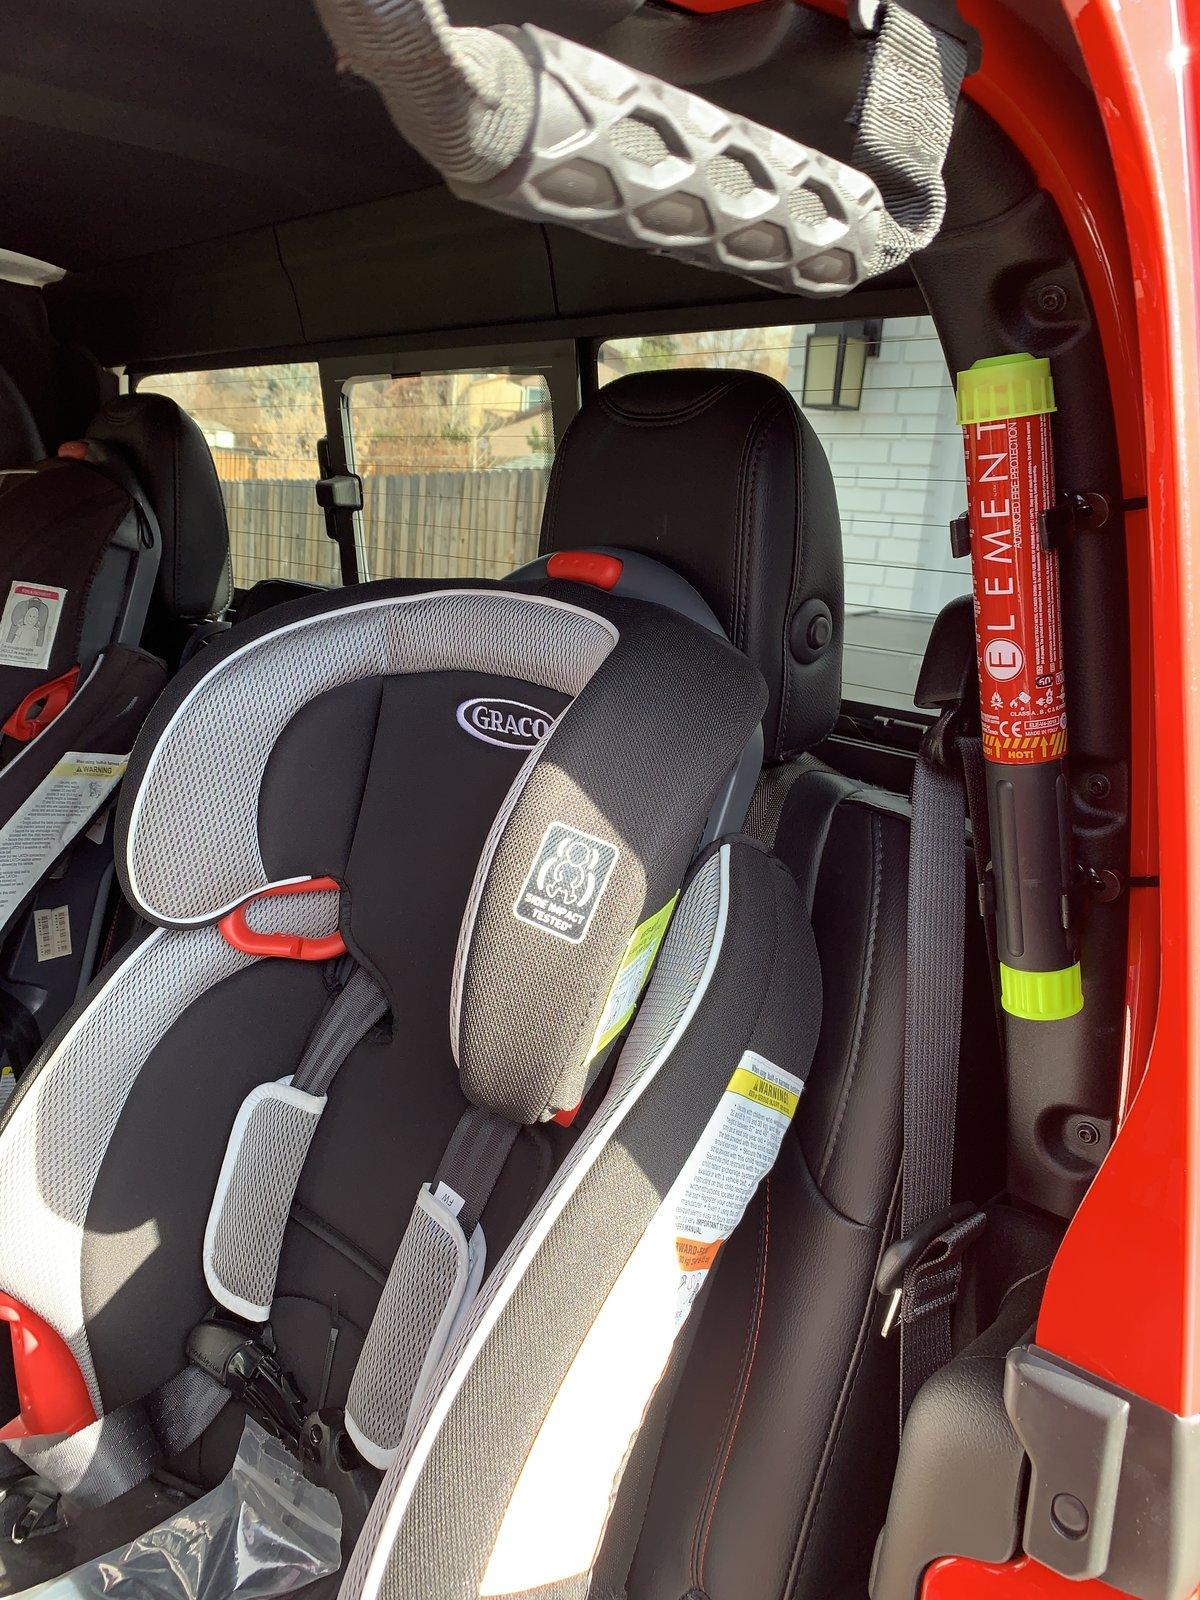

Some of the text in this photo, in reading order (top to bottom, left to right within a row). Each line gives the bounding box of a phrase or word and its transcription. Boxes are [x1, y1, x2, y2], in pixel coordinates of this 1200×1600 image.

[1008, 422, 1019, 479] PROTECTION
[1013, 501, 1022, 548] ADVANCED
[976, 422, 1018, 673] ELEMENT
[472, 704, 550, 740] GRACO
[999, 721, 1022, 738] CE
[82, 764, 112, 774] WARNING
[524, 893, 585, 926] SIDE IMPACT
